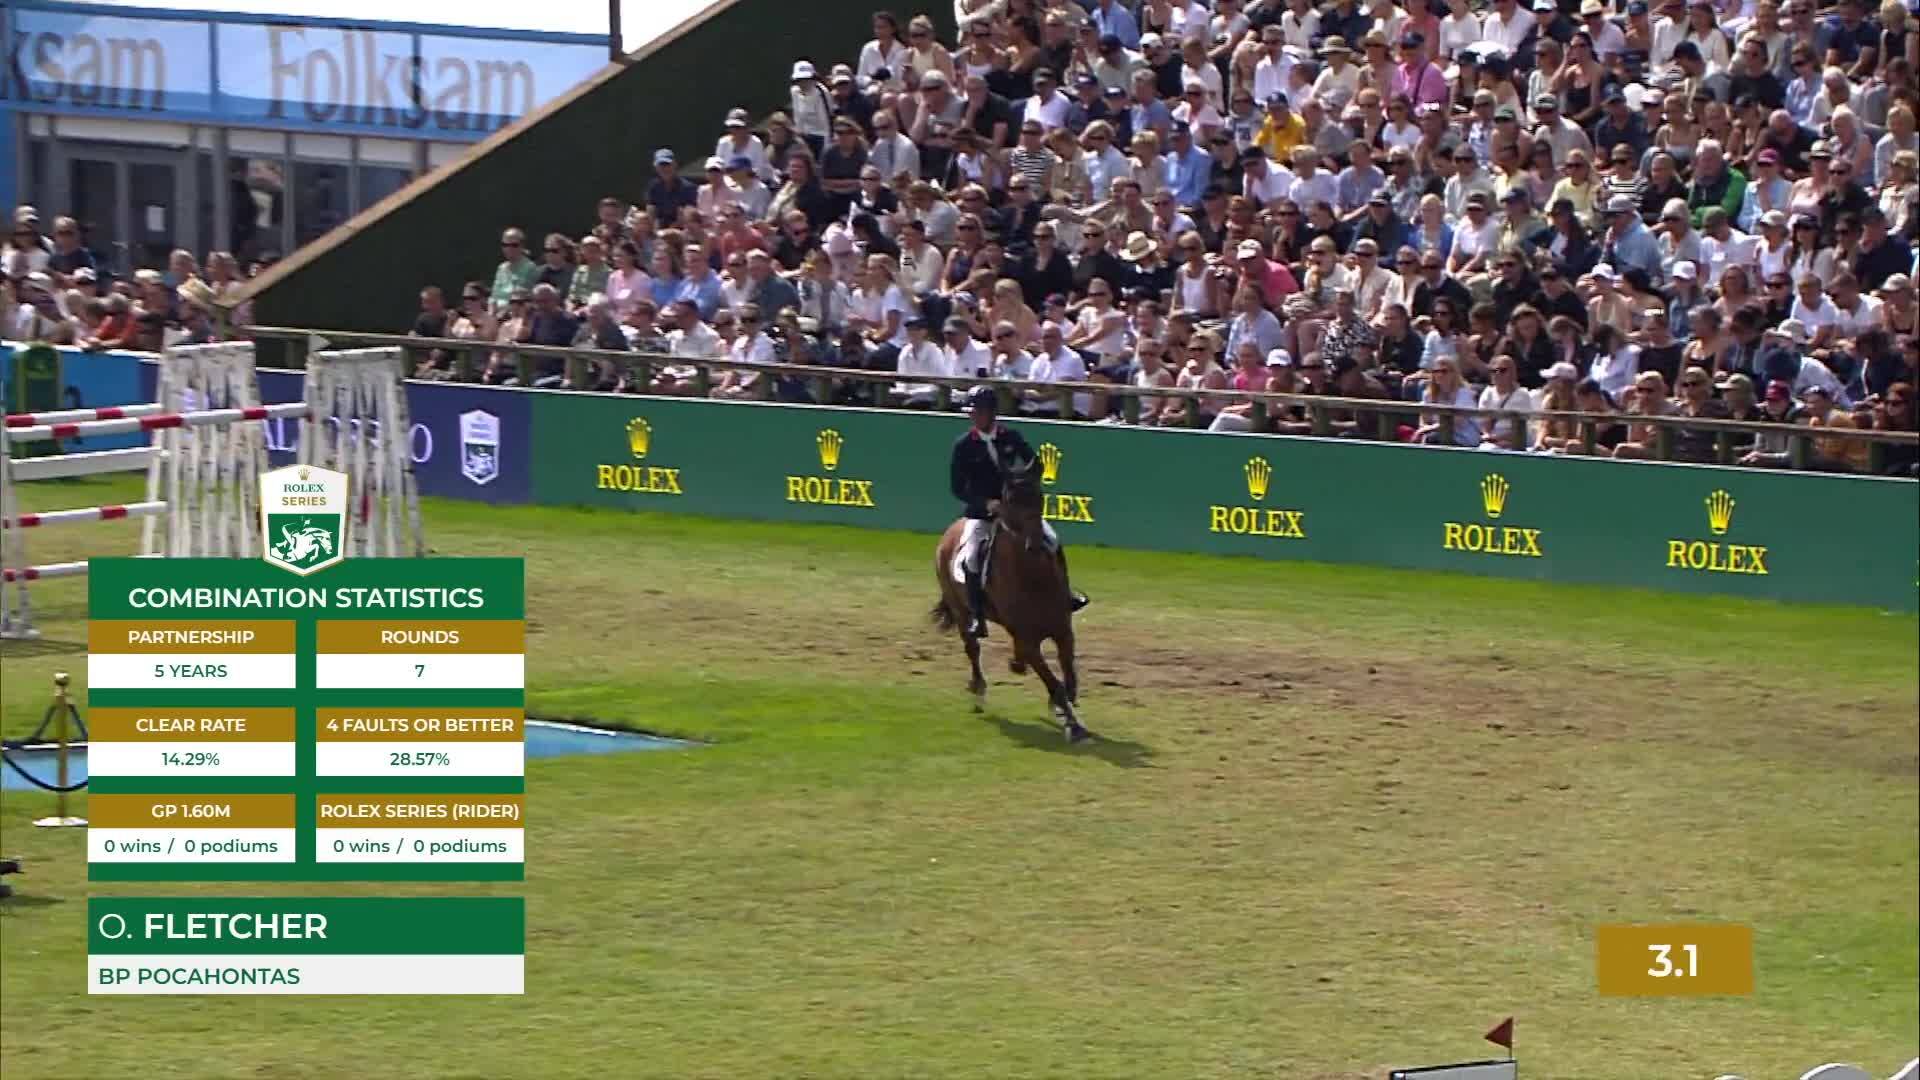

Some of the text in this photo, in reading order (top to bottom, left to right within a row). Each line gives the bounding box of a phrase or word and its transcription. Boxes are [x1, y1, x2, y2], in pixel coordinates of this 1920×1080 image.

[265, 25, 536, 131] Folksam
[597, 464, 682, 494] ROLEX
[786, 476, 875, 507] ROLEX
[1041, 494, 1095, 523] LEX
[1209, 505, 1304, 538] ROLEX
[1443, 522, 1542, 557] ROLEX
[1666, 540, 1769, 574] ROLEX
